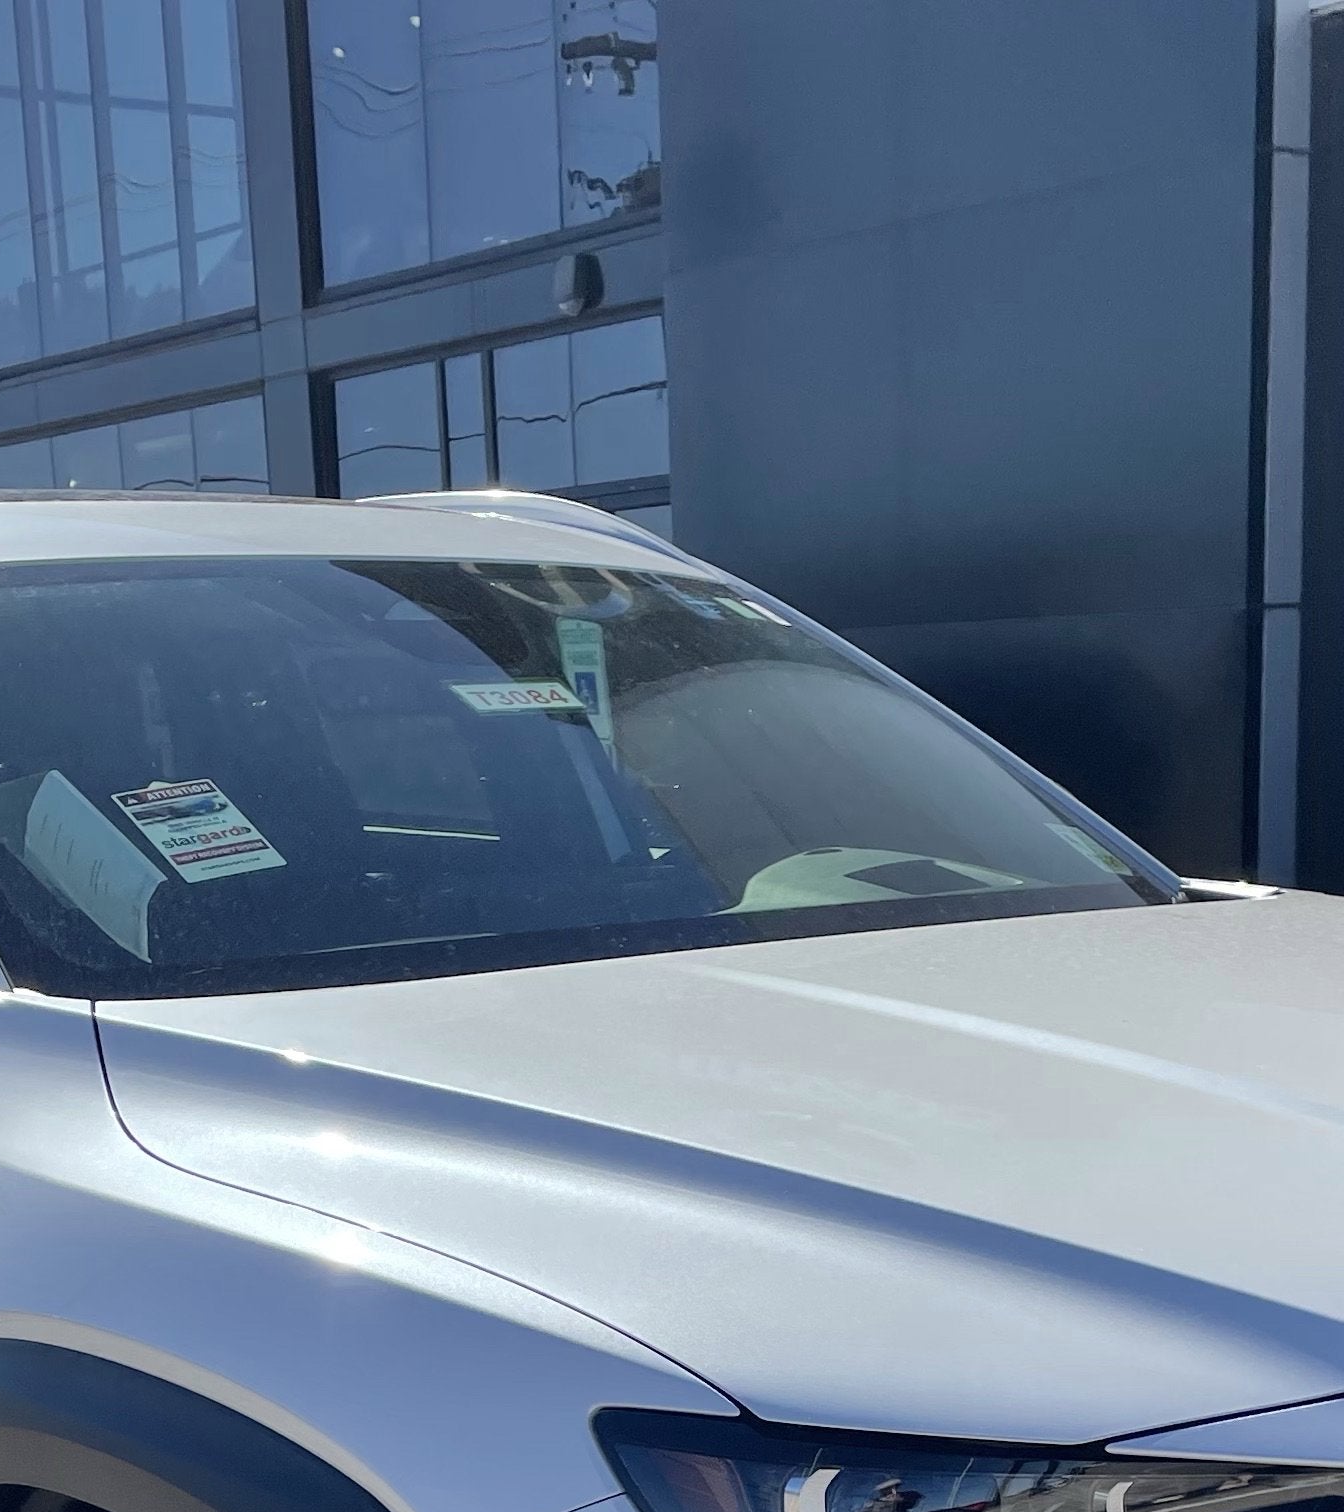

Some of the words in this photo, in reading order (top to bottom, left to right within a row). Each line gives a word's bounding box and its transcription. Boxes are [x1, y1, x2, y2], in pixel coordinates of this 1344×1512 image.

[467, 689, 568, 706] T3084
[147, 783, 210, 800] ATTENTION
[161, 825, 241, 849] stargard
